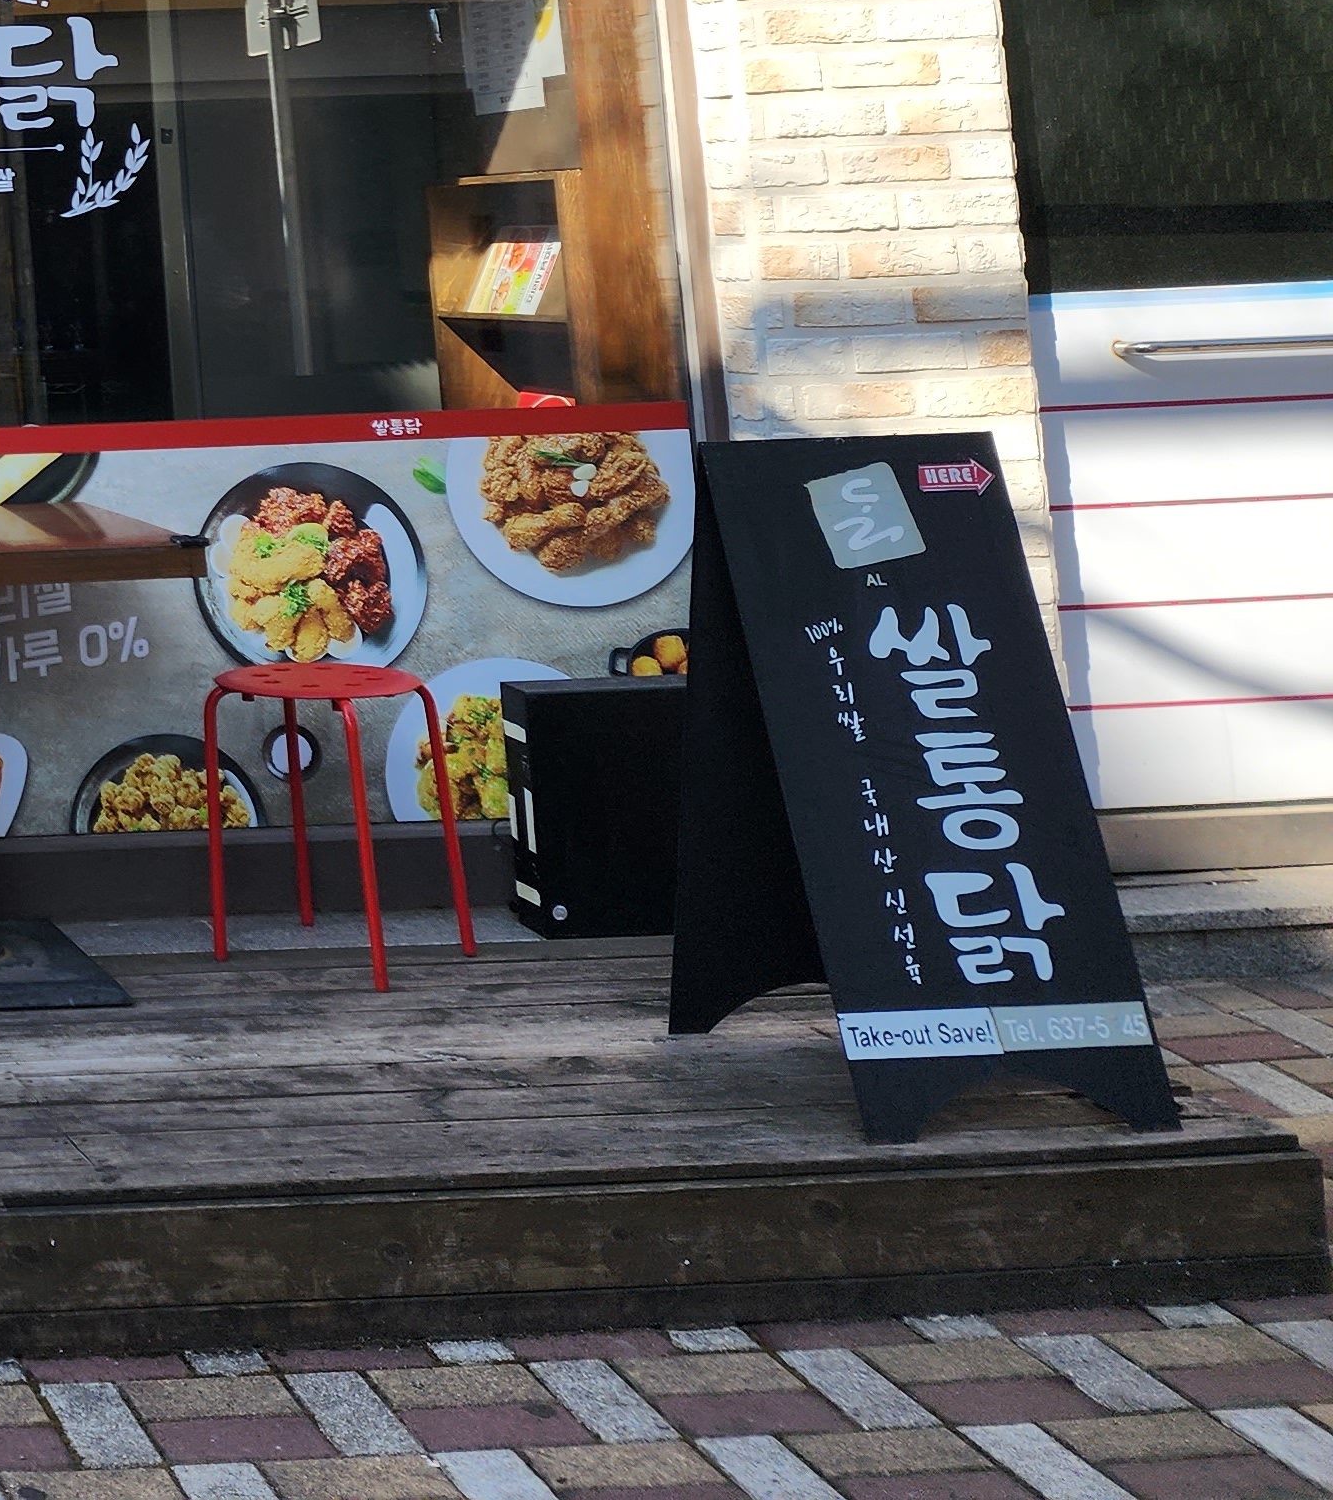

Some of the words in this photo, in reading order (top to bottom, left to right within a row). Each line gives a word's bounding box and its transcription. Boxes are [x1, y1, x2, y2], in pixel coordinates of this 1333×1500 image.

[369, 416, 424, 437] 쌀통닭
[924, 465, 979, 484] HERE!
[866, 573, 888, 587] AL
[78, 615, 151, 668] 0%
[804, 617, 844, 644] 100%
[828, 646, 867, 743] 우리쌀
[868, 602, 1067, 985] 쌀통닭
[847, 1024, 934, 1049] Take-out
[936, 1019, 996, 1046] Save!
[1001, 1018, 1046, 1044] Tel.
